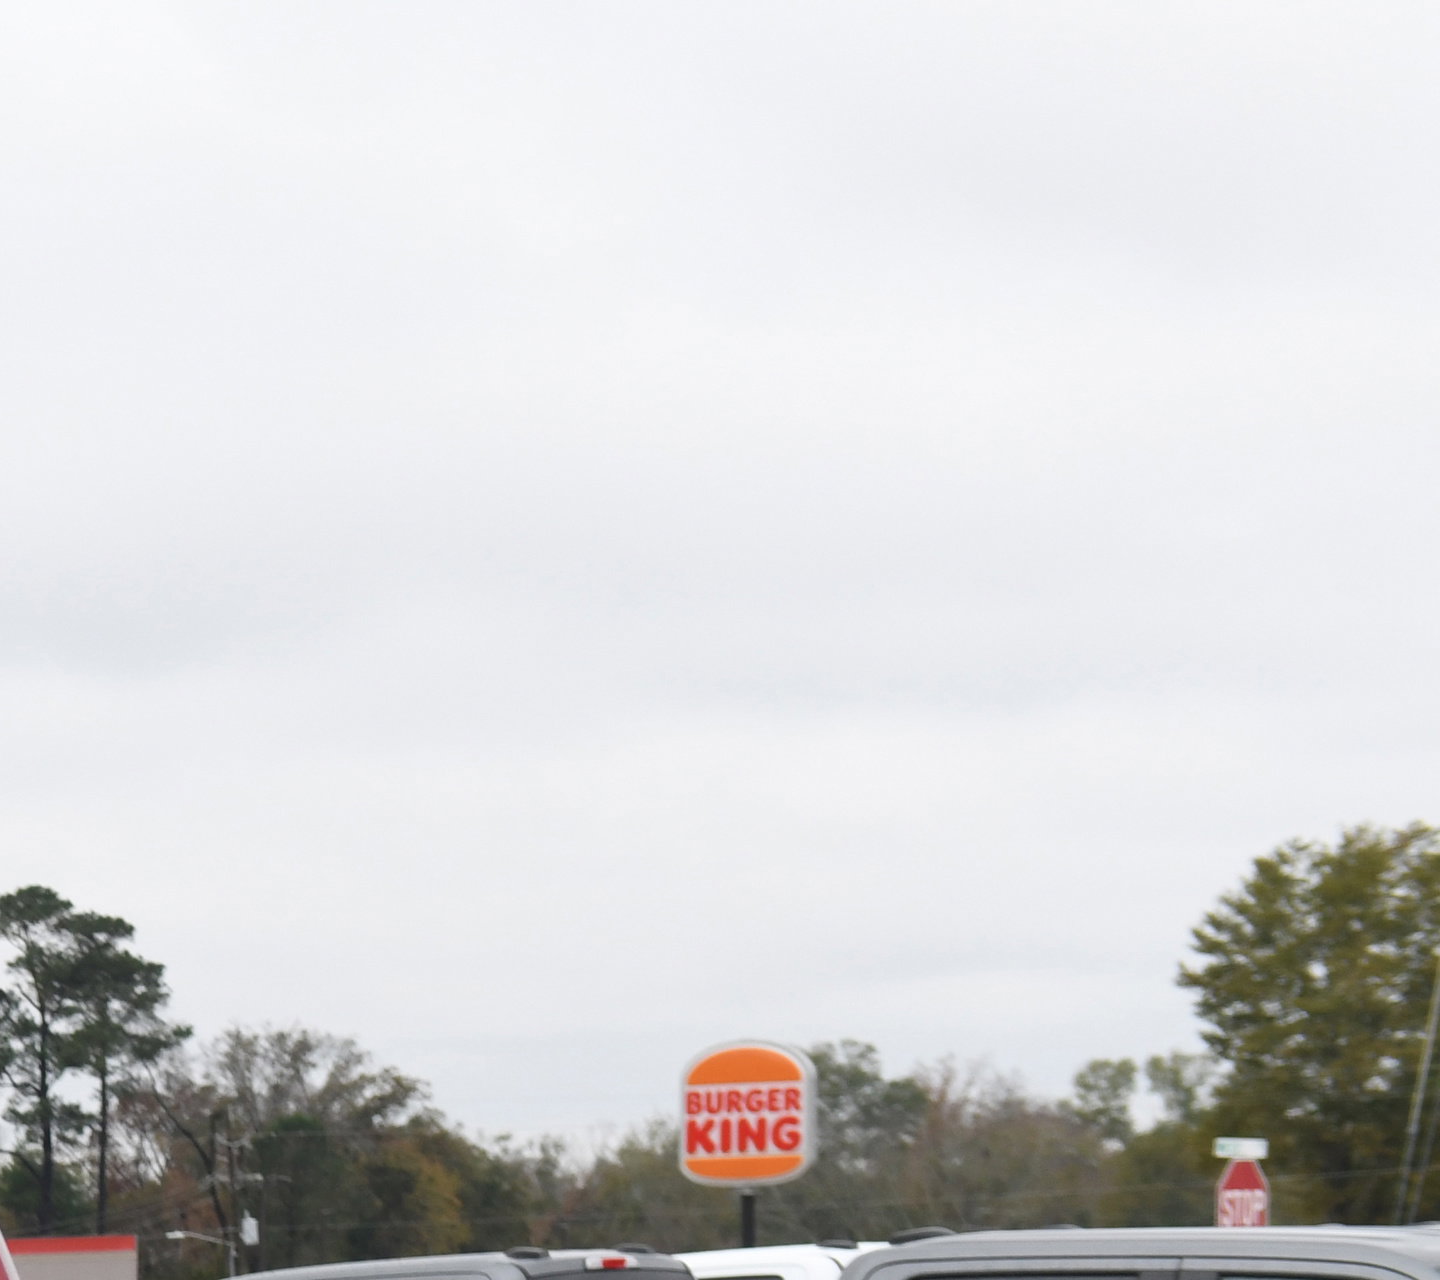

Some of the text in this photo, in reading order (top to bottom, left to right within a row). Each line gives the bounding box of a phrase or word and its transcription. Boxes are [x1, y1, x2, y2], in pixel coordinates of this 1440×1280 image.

[685, 1087, 802, 1115] BURGER
[685, 1115, 802, 1155] KING
[1220, 1188, 1266, 1228] STOP
